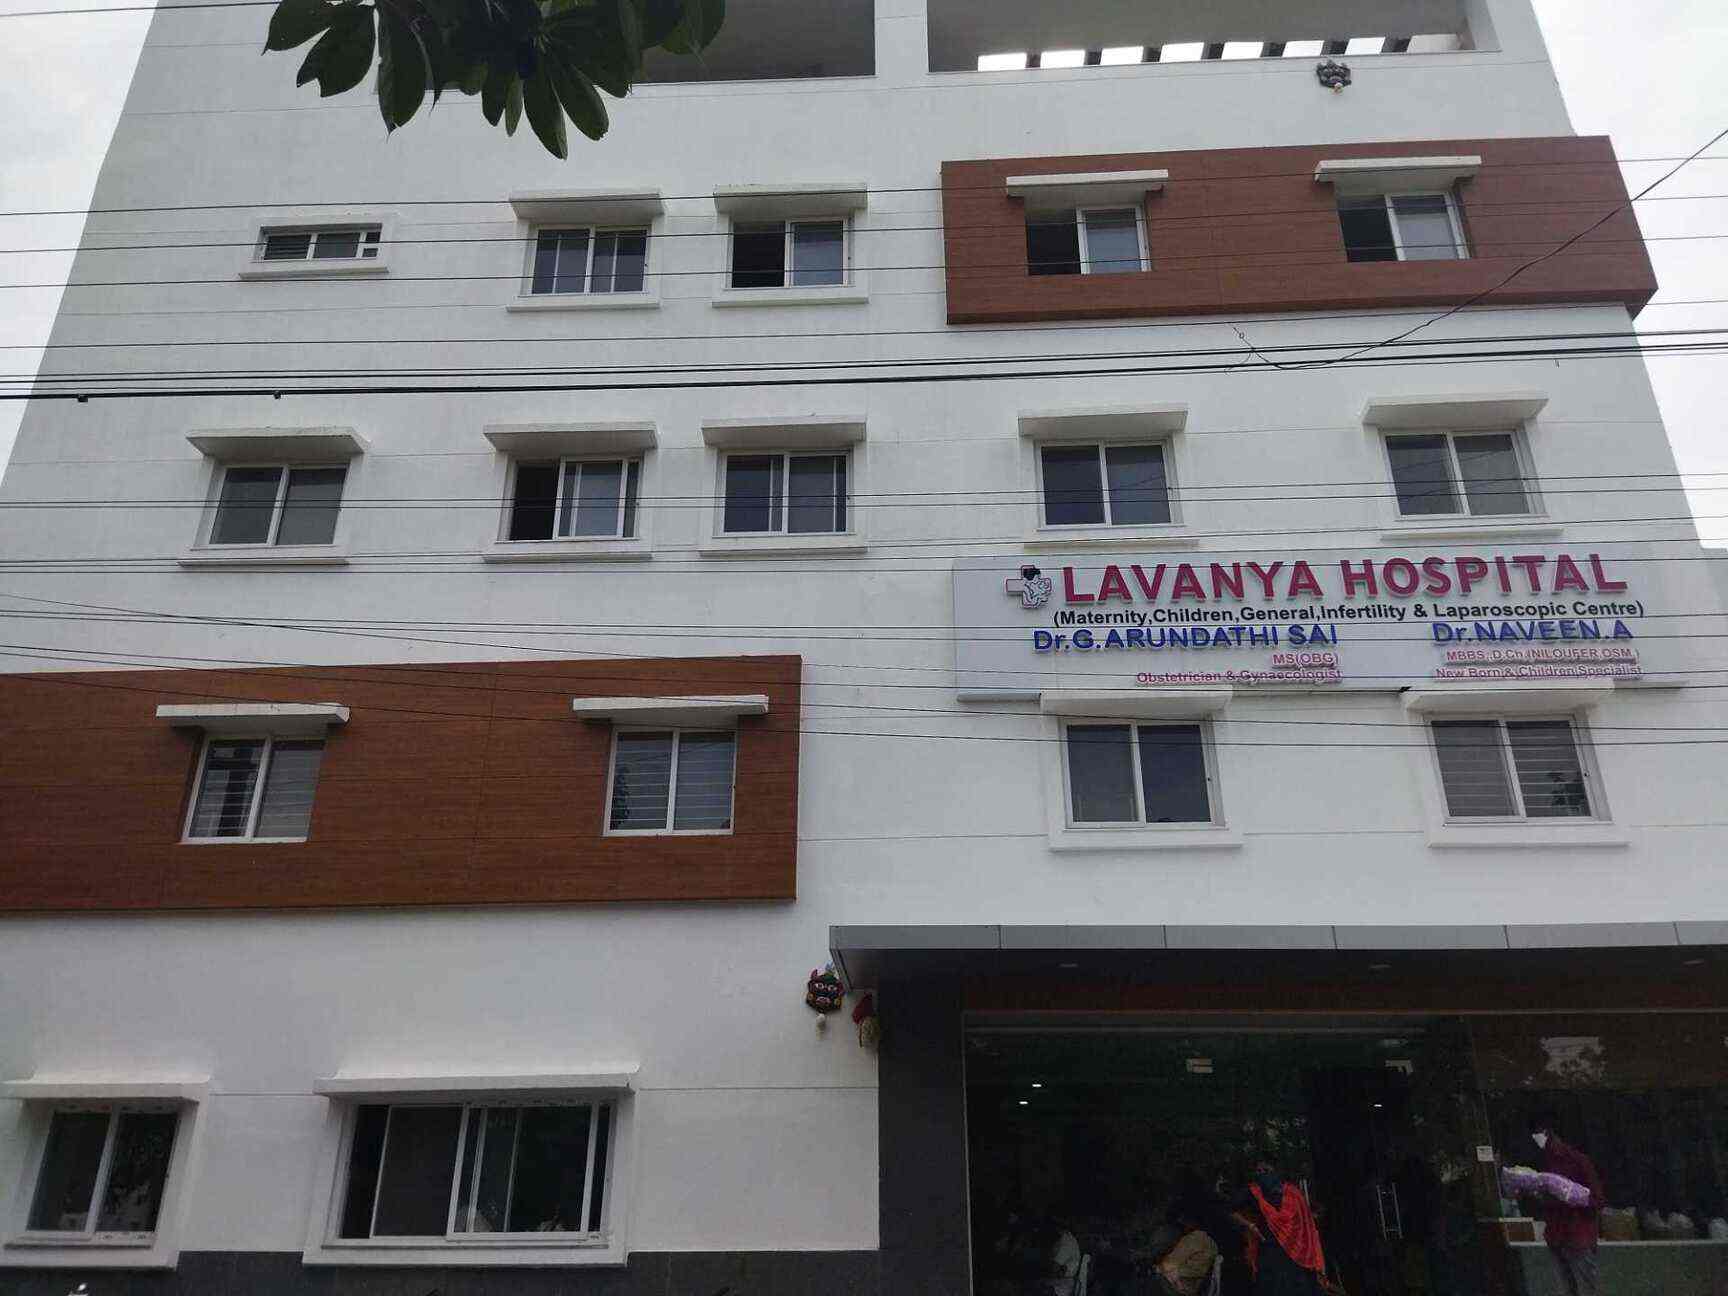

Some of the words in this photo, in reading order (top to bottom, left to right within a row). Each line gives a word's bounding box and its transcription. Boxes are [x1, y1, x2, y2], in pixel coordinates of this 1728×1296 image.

[1063, 560, 1324, 604] LAVANYA
[1340, 553, 1629, 598] HOSPITAL
[1413, 602, 1429, 618] &
[1433, 601, 1567, 622] Laparoscopic
[1572, 600, 1645, 619] Centre)
[1033, 624, 1279, 651] Dr.G.ARUNDATHI
[1288, 623, 1338, 646] SAI
[1432, 618, 1634, 643] Dr.NAVEEN.A
[1273, 651, 1339, 667] MS(OBG)
[1136, 670, 1221, 684] Obstetrician
[1226, 669, 1237, 682] &
[1239, 668, 1343, 684] Gynaecologist
[1436, 667, 1465, 679] New
[1468, 666, 1500, 678] Born
[1503, 665, 1515, 677] &
[1518, 662, 1577, 678] Children
[1577, 662, 1642, 679] Specialist
